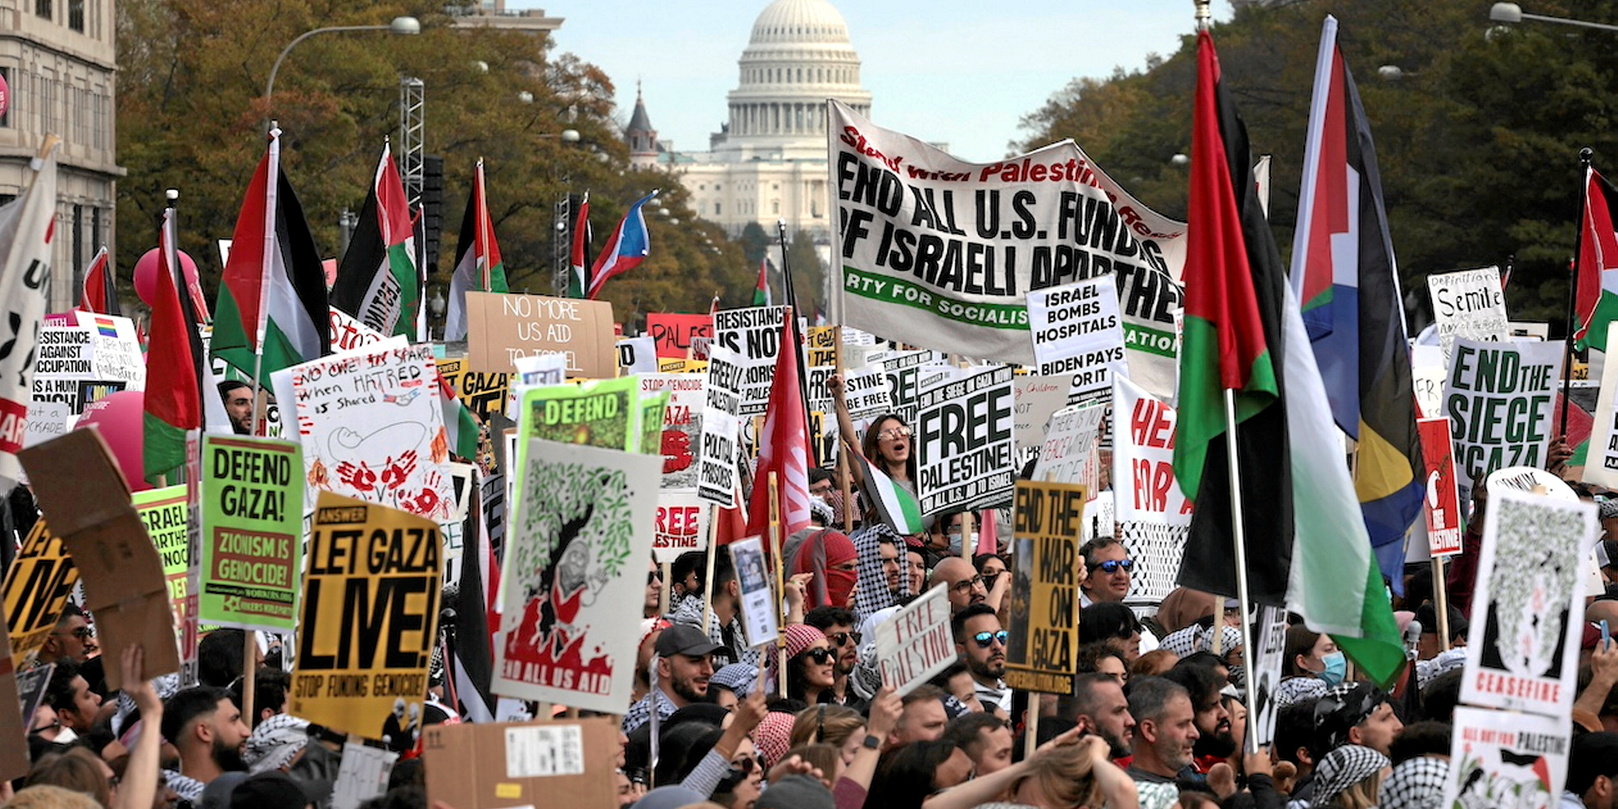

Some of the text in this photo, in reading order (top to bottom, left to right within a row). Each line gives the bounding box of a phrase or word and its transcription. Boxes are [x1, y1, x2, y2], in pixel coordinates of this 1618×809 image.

[841, 151, 903, 217] END
[908, 185, 967, 236] ALL
[976, 190, 1047, 239] U.S.
[876, 220, 1016, 296] ISRAELI
[503, 296, 581, 320] NO MORE
[893, 285, 932, 305] FOR
[1045, 284, 1099, 308] ISRAEL
[1048, 301, 1100, 324] BOMBS
[518, 322, 571, 342] US AID
[719, 330, 740, 355] IS
[1036, 315, 1116, 344] HOSPITALS
[40, 346, 81, 359] AGAINST
[1042, 347, 1123, 376] BIDEN PAYS
[301, 367, 321, 385] NO
[328, 362, 356, 380] ONE
[354, 364, 421, 393] HATRED
[463, 371, 508, 396] GAZA
[1095, 368, 1107, 383] IT
[1452, 345, 1553, 393] END THE
[642, 379, 663, 391] STOP
[848, 391, 888, 409] BE FREE
[934, 389, 945, 402] THE
[946, 381, 966, 398] SIEGE
[976, 374, 993, 390] GAZA
[545, 394, 618, 425] DEFEND
[1447, 393, 1550, 444] SIEGE
[920, 385, 1011, 467] FREE
[214, 448, 291, 487] DEFEND
[920, 440, 1011, 495] PALESTINE!
[1466, 443, 1539, 481] GAZA
[221, 484, 285, 522] GAZA!
[934, 491, 947, 507] ALL
[977, 478, 986, 493] TO
[988, 471, 1013, 491] ISRAEL
[318, 507, 366, 524] ANSWER
[1016, 487, 1043, 534] END
[1048, 490, 1081, 536] THE
[219, 532, 289, 559] ZIONISM IS
[310, 528, 438, 575] LET GAZA
[218, 559, 287, 585] GENOCIDE!
[1039, 537, 1074, 585] WAR
[298, 576, 436, 670] LIVE!
[894, 599, 939, 644] FREE
[1050, 587, 1073, 629] ON
[881, 619, 950, 687] PALESTINE
[1032, 627, 1071, 672] GAZA
[295, 674, 323, 698] STOP
[373, 673, 425, 697] GENOCIDE!
[523, 662, 547, 684] ALL
[553, 667, 573, 689] US
[579, 672, 611, 695] AID
[1476, 671, 1560, 703] CEASEFIRE
[1517, 731, 1566, 755] PALESTINE
